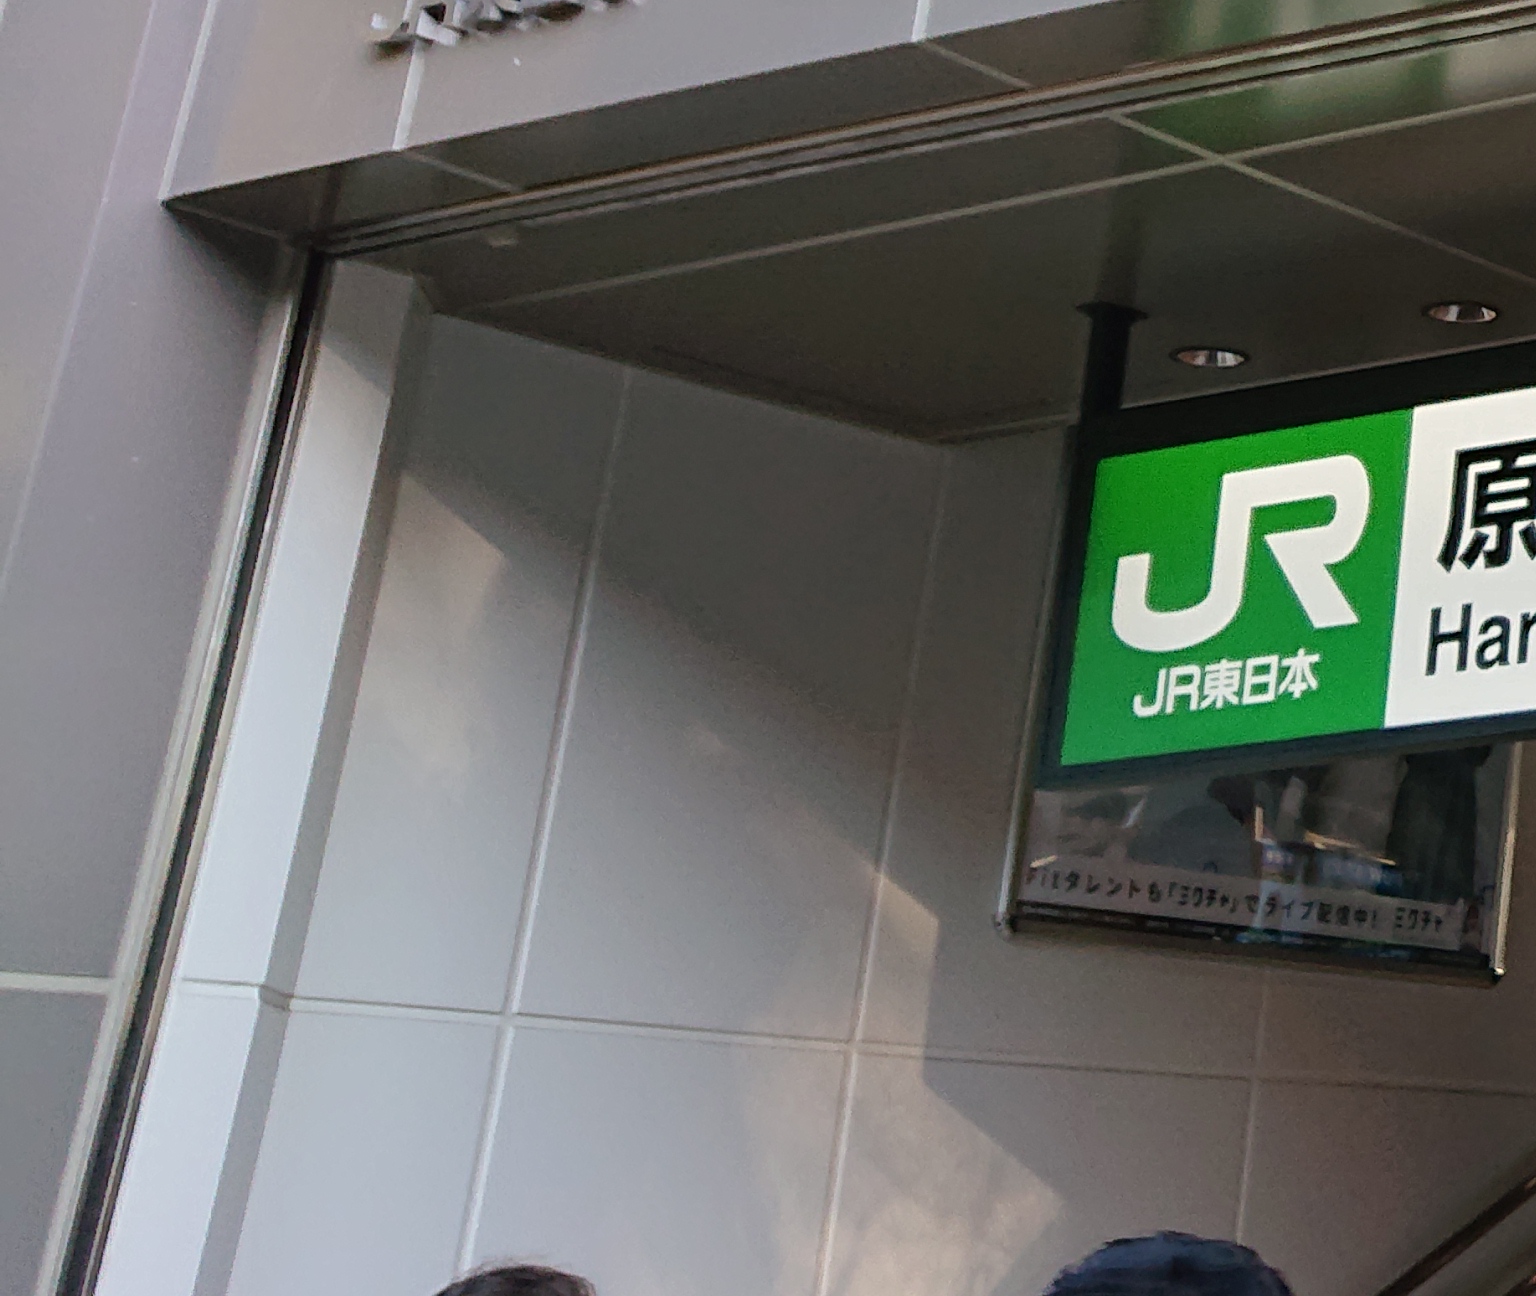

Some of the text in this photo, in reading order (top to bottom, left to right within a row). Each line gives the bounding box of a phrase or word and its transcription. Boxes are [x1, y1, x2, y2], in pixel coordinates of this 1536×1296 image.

[1111, 453, 1371, 654] JR
[1131, 646, 1321, 720] JR東日本
